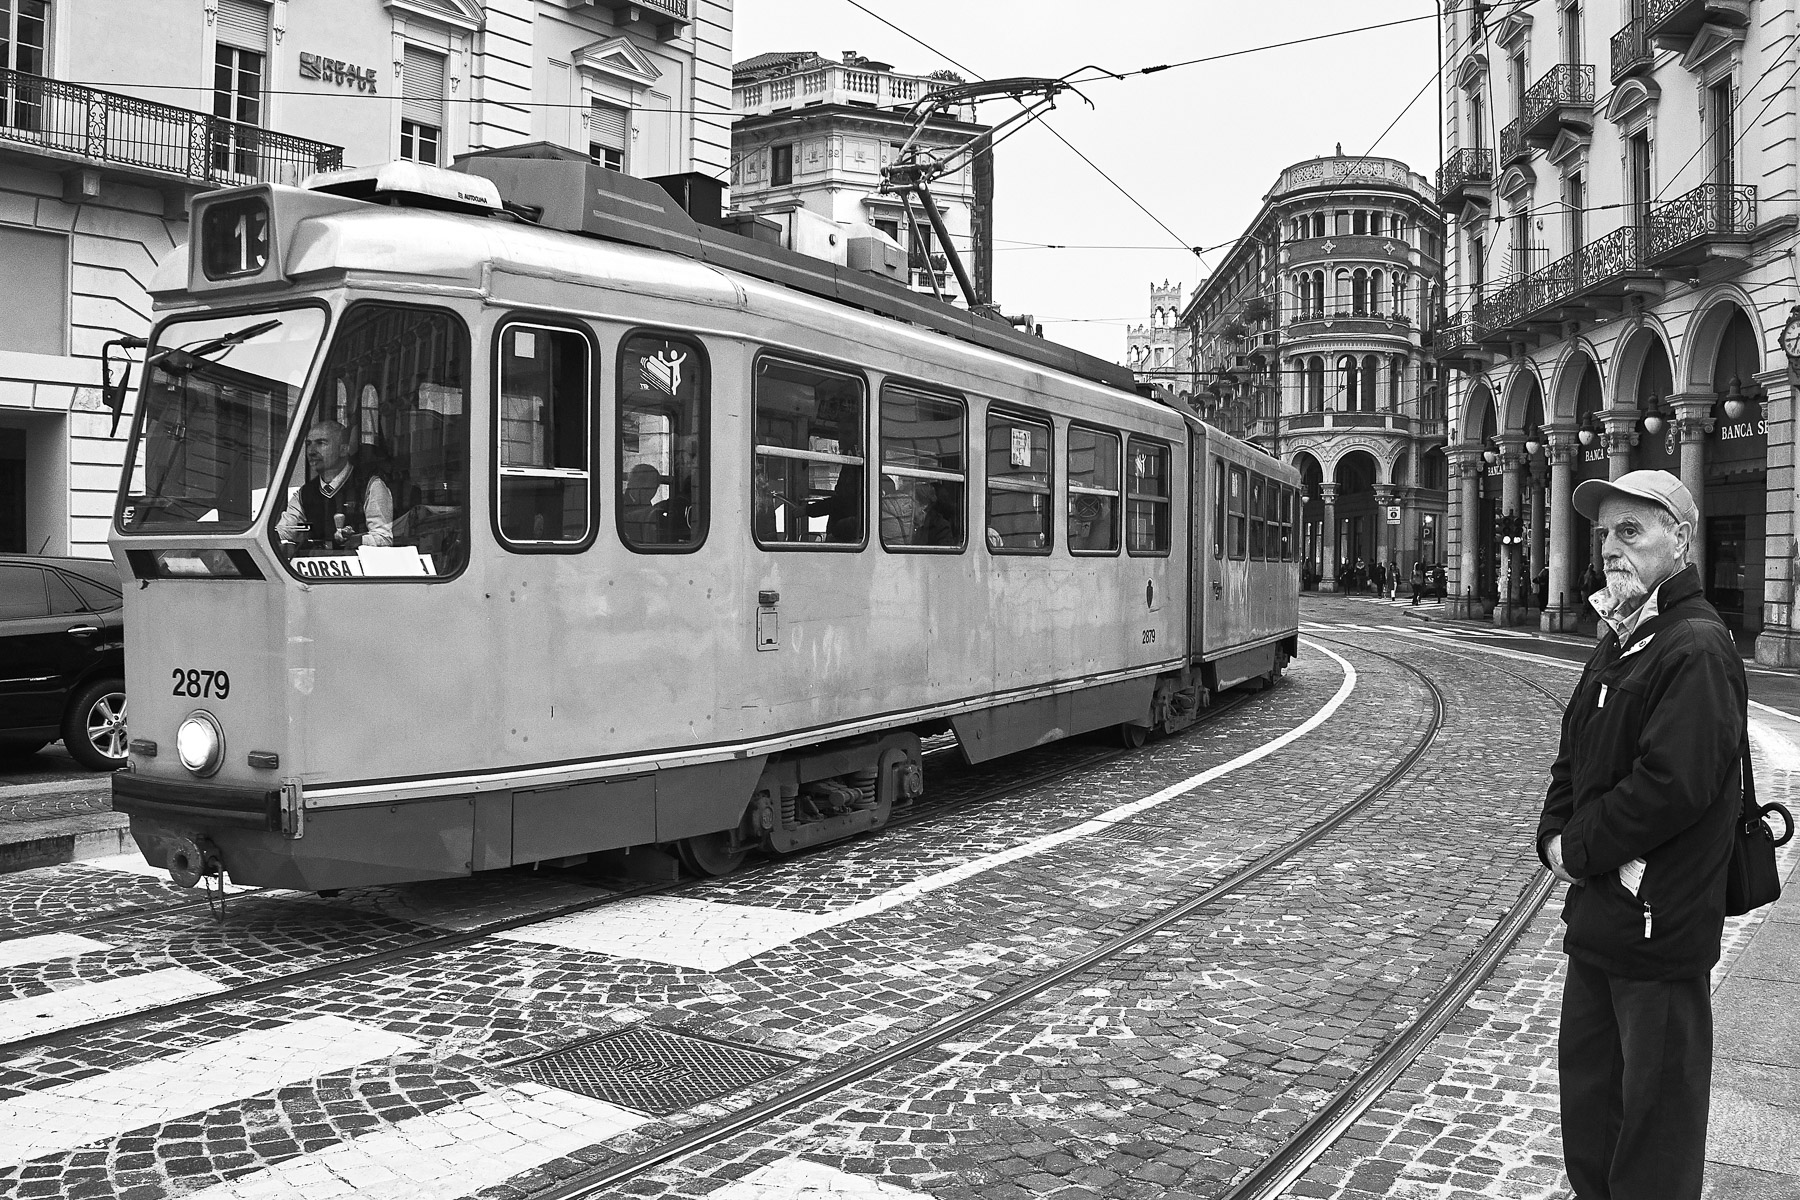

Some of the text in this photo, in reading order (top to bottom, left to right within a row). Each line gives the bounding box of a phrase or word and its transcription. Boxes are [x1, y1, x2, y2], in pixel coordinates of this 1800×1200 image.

[322, 57, 376, 82] REALE
[322, 71, 377, 95] MUTUA
[1721, 423, 1753, 440] BANCA
[1585, 448, 1604, 462] BANCA
[296, 560, 353, 577] CORSA
[1142, 629, 1156, 644] 2879
[172, 668, 230, 700] 2879
